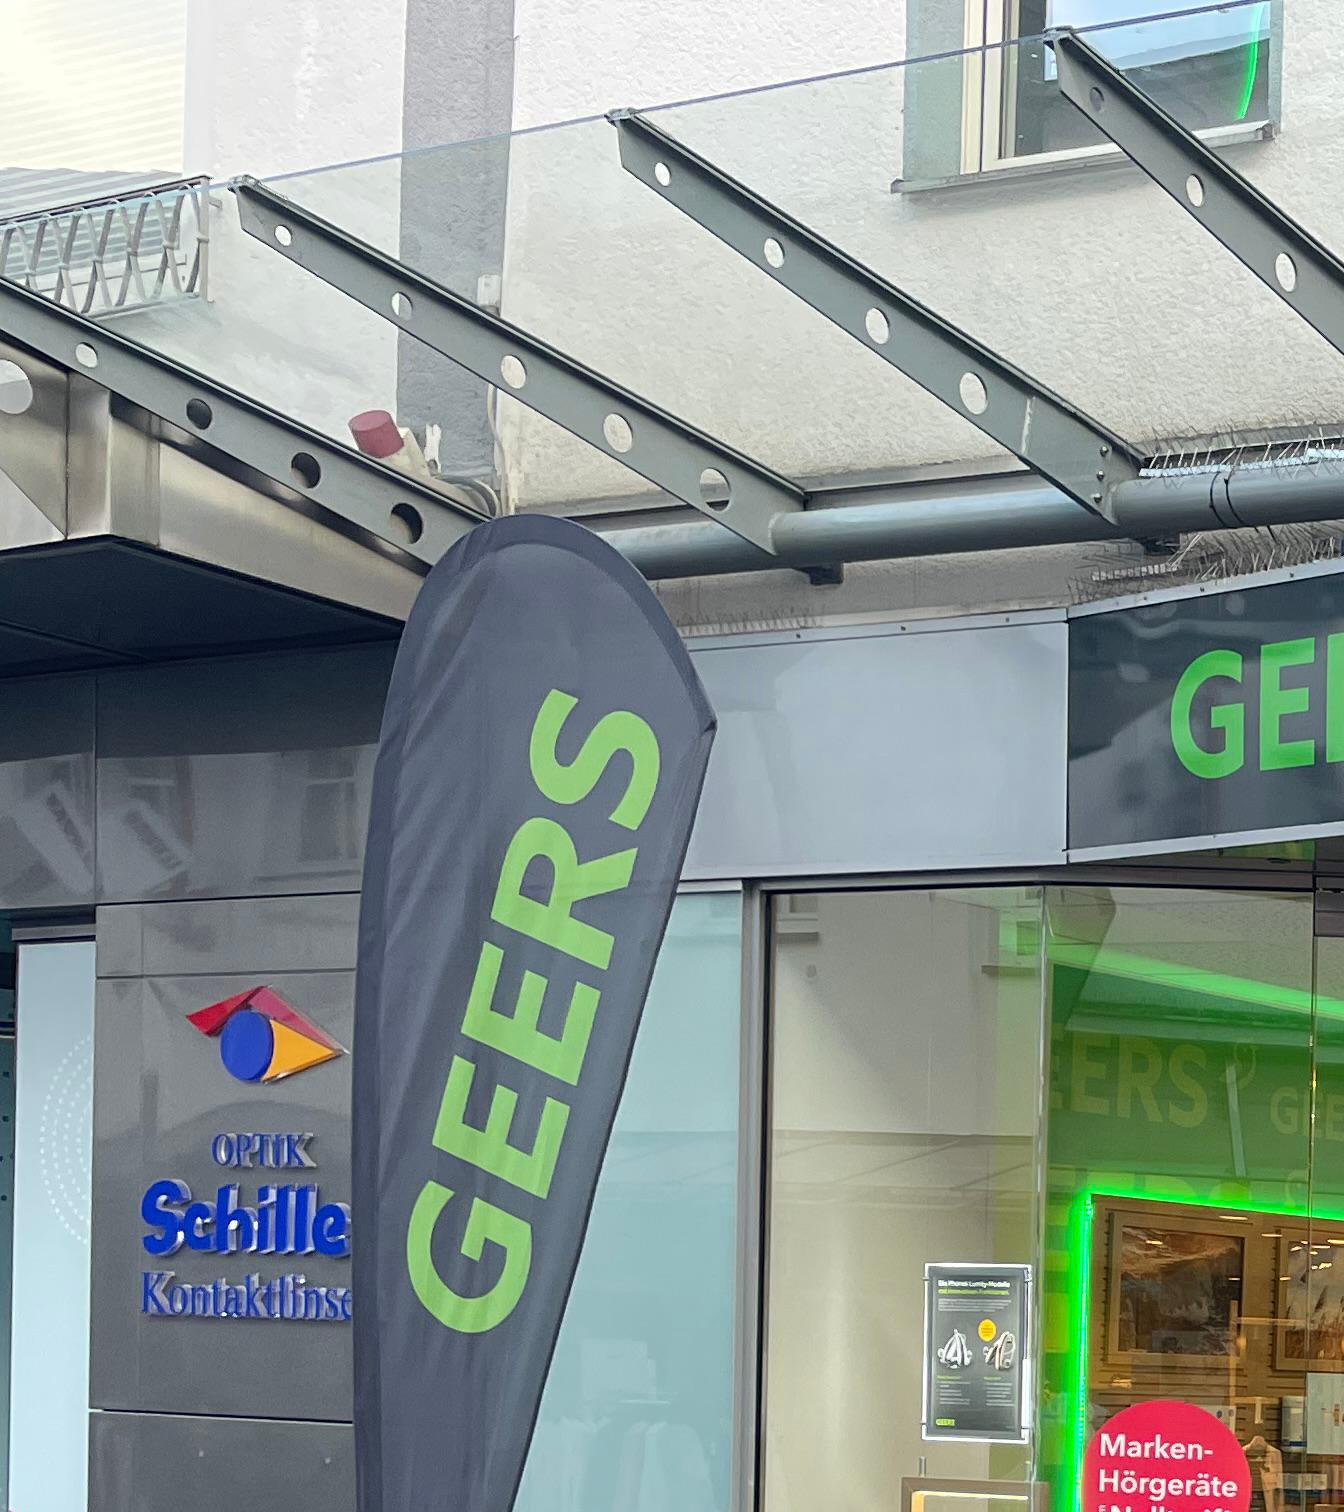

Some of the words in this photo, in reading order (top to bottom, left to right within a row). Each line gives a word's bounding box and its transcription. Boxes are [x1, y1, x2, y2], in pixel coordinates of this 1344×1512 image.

[406, 688, 661, 1334] GEERS
[211, 1132, 318, 1169] OPTIK
[1099, 1433, 1214, 1461] Marken-
[1098, 1468, 1239, 1502] Hörgeräte
